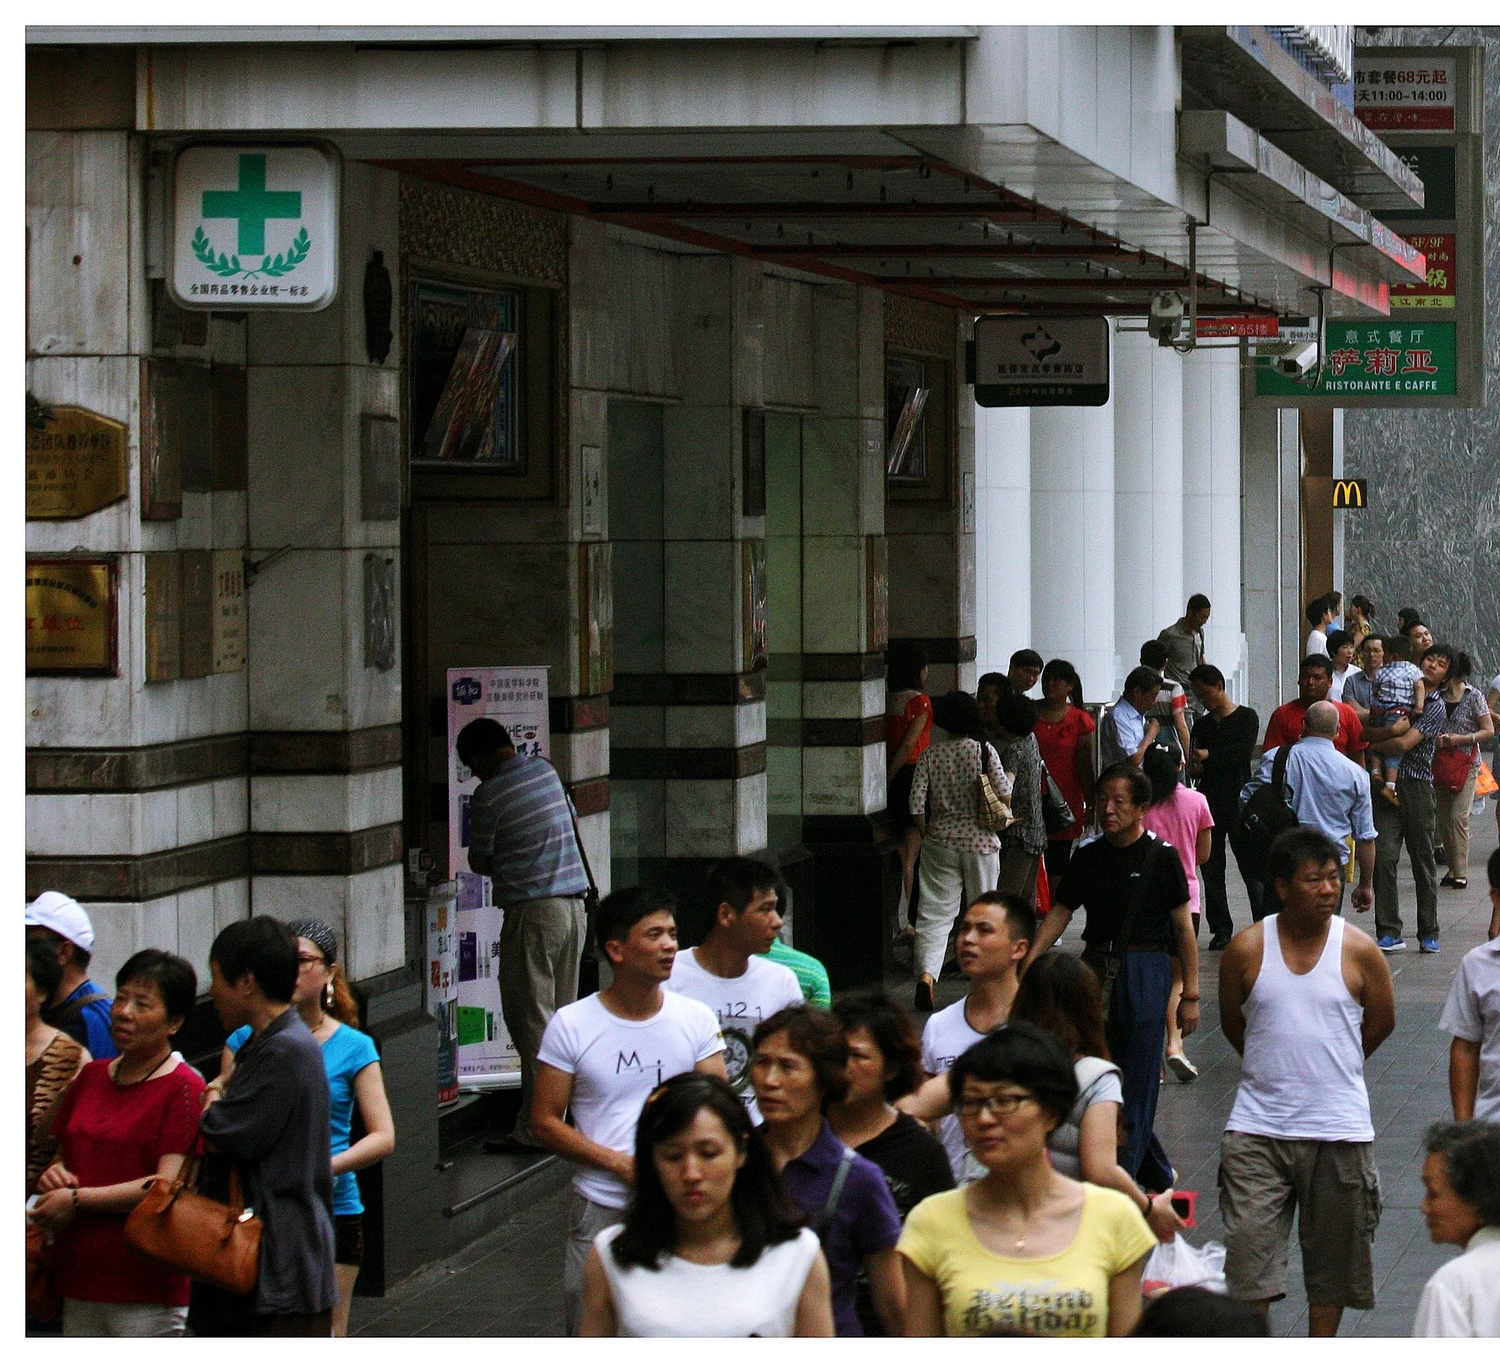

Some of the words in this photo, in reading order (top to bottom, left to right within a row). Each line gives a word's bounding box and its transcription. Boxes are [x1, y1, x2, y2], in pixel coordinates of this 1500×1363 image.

[1354, 90, 1447, 102] 天11:00-14:00)
[189, 283, 310, 297] 全国药品零售企业统一标志
[1345, 329, 1425, 344] 意式餐厅
[1329, 348, 1438, 376] 萨莉亚
[1326, 381, 1391, 391] RISTORANTE
[1395, 381, 1402, 391] E
[1405, 381, 1438, 391] CAFFE
[726, 1001, 748, 1019] 12
